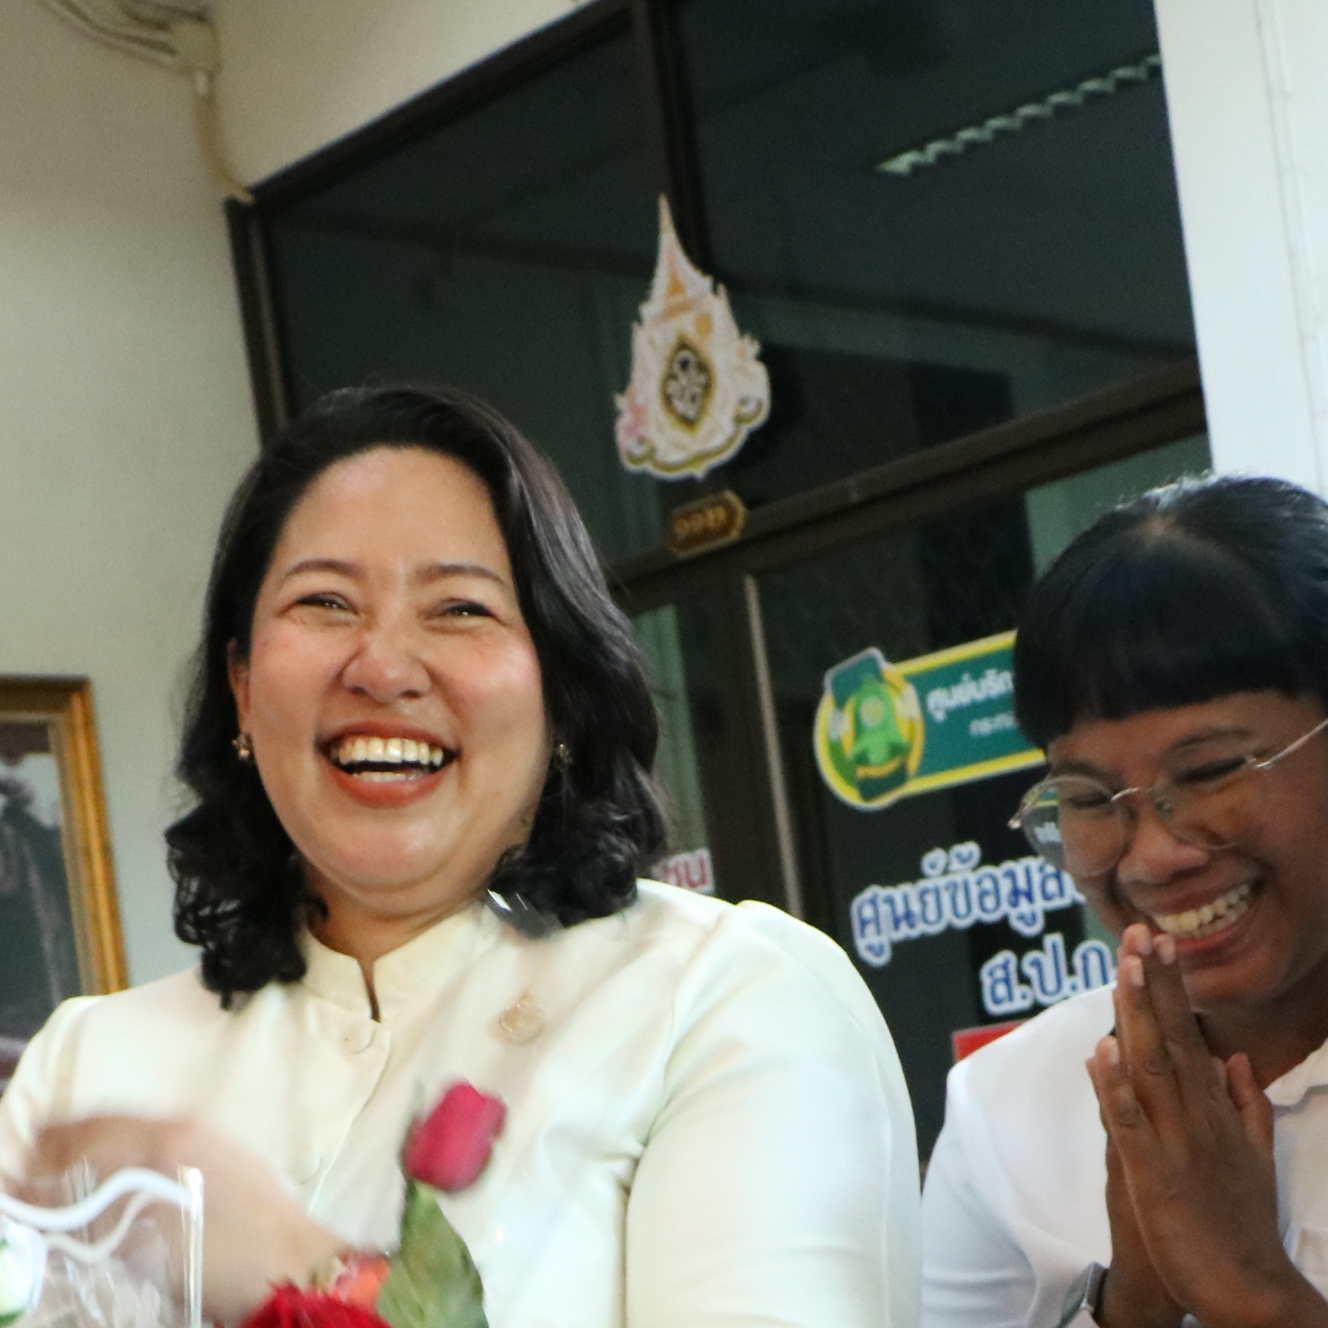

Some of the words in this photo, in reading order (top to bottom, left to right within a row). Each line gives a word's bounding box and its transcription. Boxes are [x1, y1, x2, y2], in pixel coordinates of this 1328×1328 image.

[851, 840, 1086, 967] ศูนย์ข้อมูล
